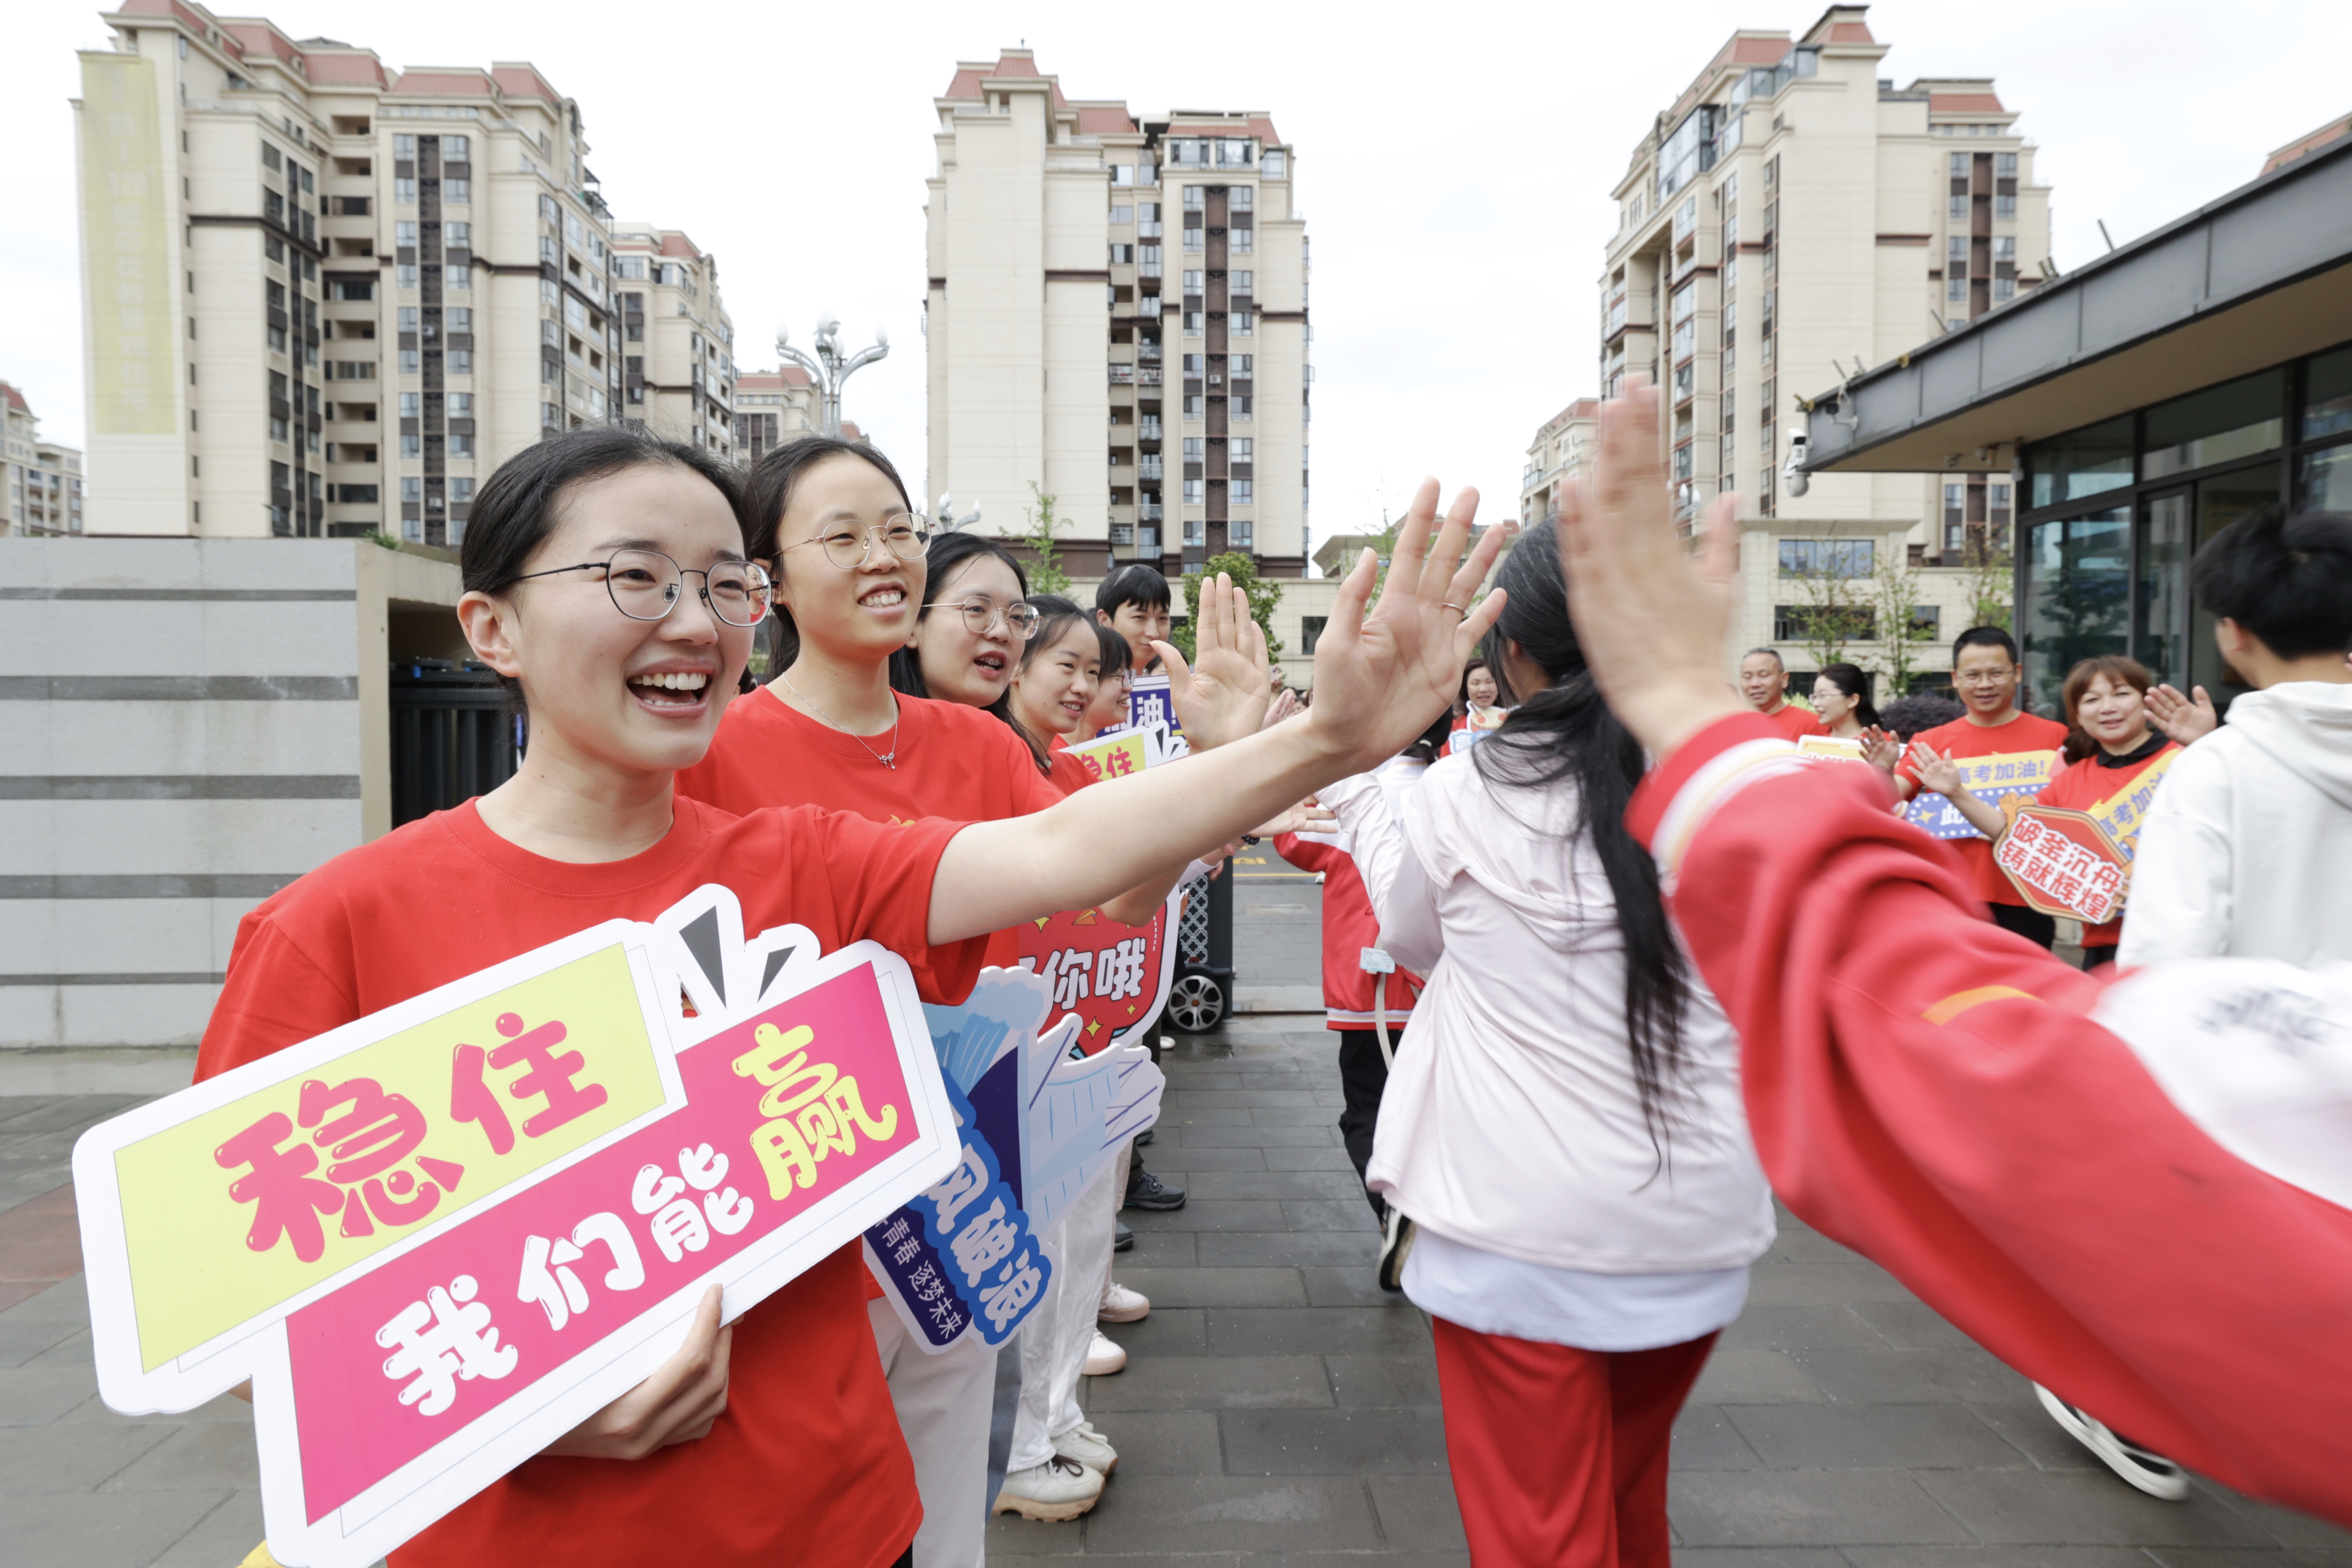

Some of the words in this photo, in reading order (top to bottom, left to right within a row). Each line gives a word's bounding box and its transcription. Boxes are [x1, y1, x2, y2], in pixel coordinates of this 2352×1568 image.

[1958, 760, 2045, 784] 高考加油!
[2001, 840, 2109, 921] 铸就辉煌
[2012, 815, 2122, 894] 破釜沉舟
[1019, 937, 1145, 1010] 你哦
[215, 1013, 607, 1262] 稳住
[375, 1022, 897, 1416] 我们能赢
[919, 1098, 1041, 1332] 风破浪
[875, 1216, 921, 1266] 青春
[908, 1260, 962, 1339] 逐梦未来
